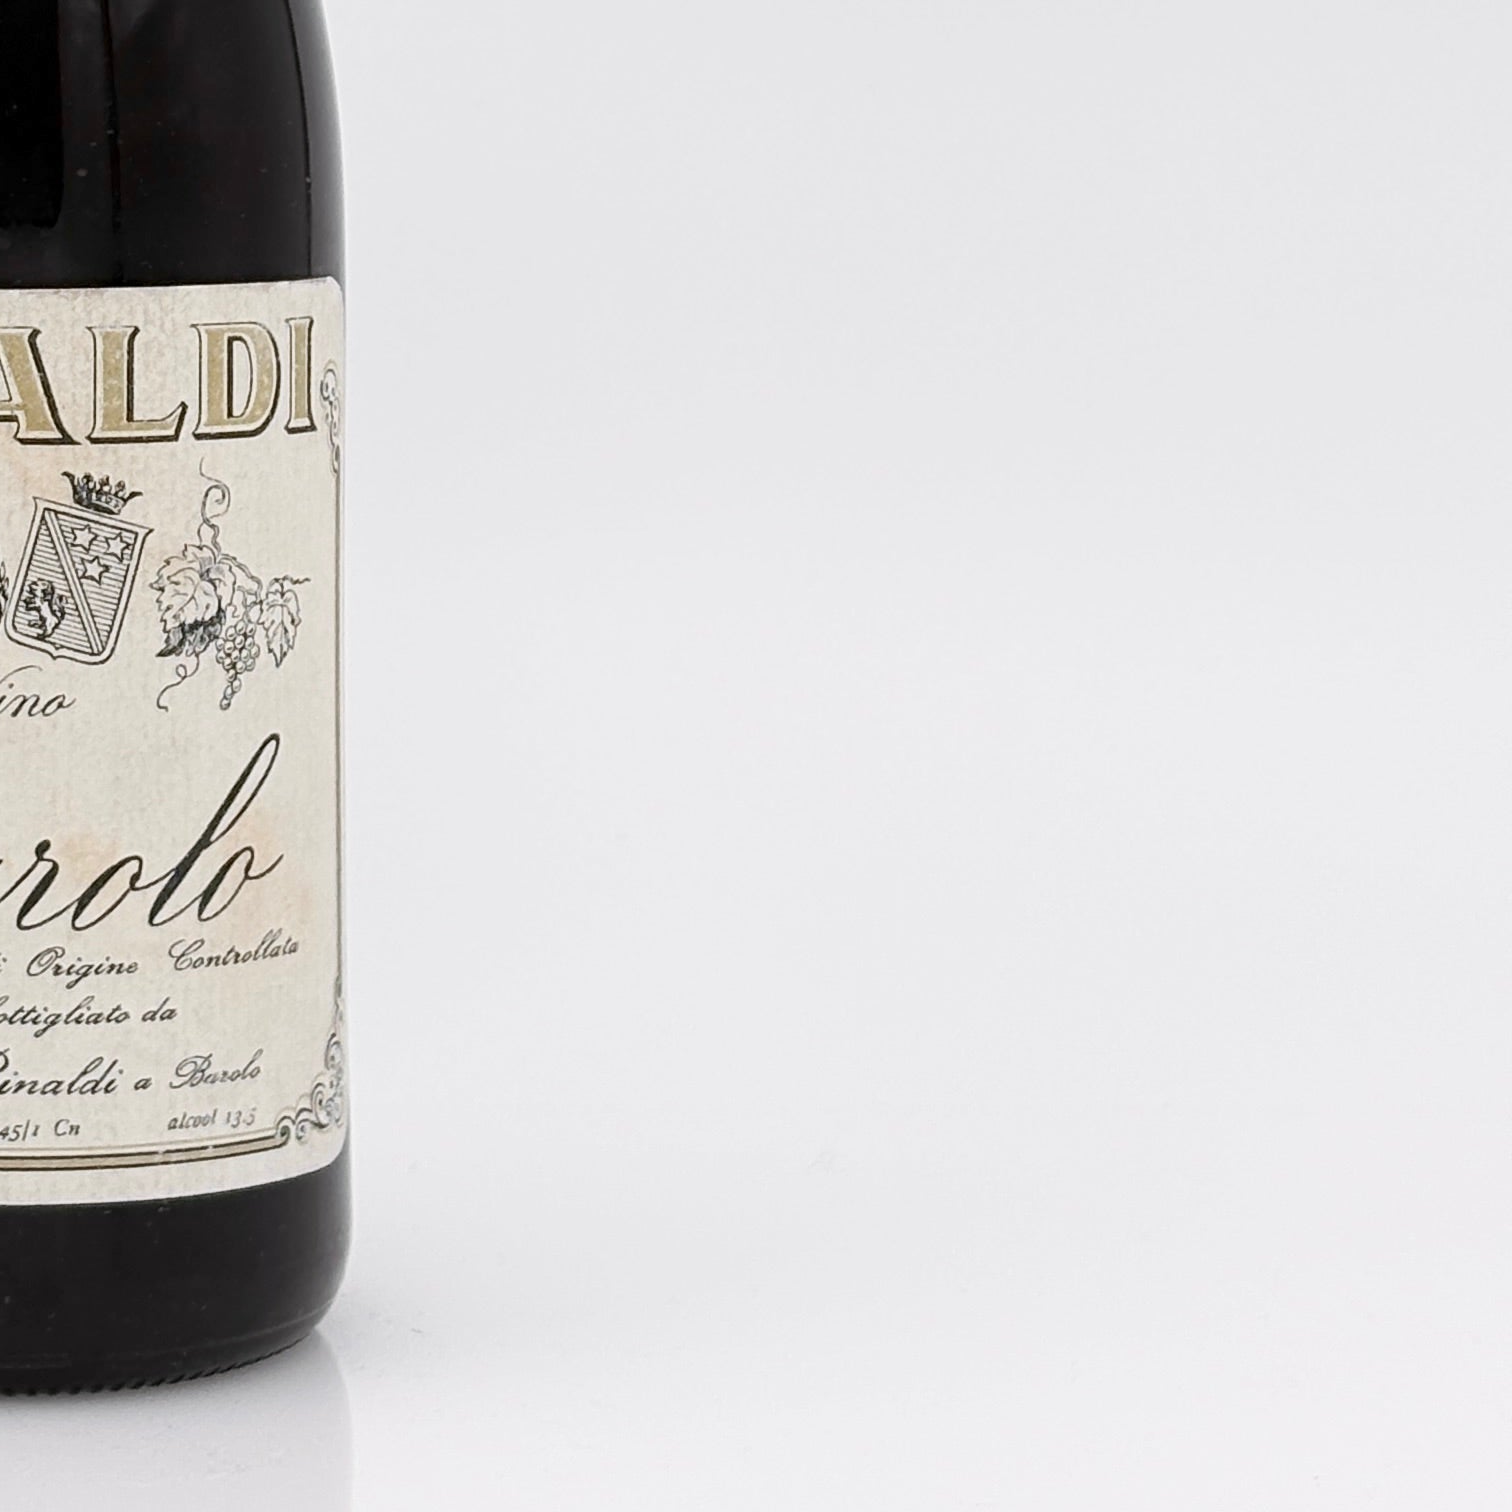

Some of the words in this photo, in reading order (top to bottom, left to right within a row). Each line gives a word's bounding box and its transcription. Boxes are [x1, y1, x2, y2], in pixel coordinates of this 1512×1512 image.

[26, 946, 139, 989] Origine
[168, 928, 299, 972] Controllata
[141, 997, 178, 1023] da
[133, 1077, 152, 1091] a
[169, 1048, 264, 1089] Barolo
[54, 1118, 81, 1137] Cn
[168, 1108, 218, 1130] alcool
